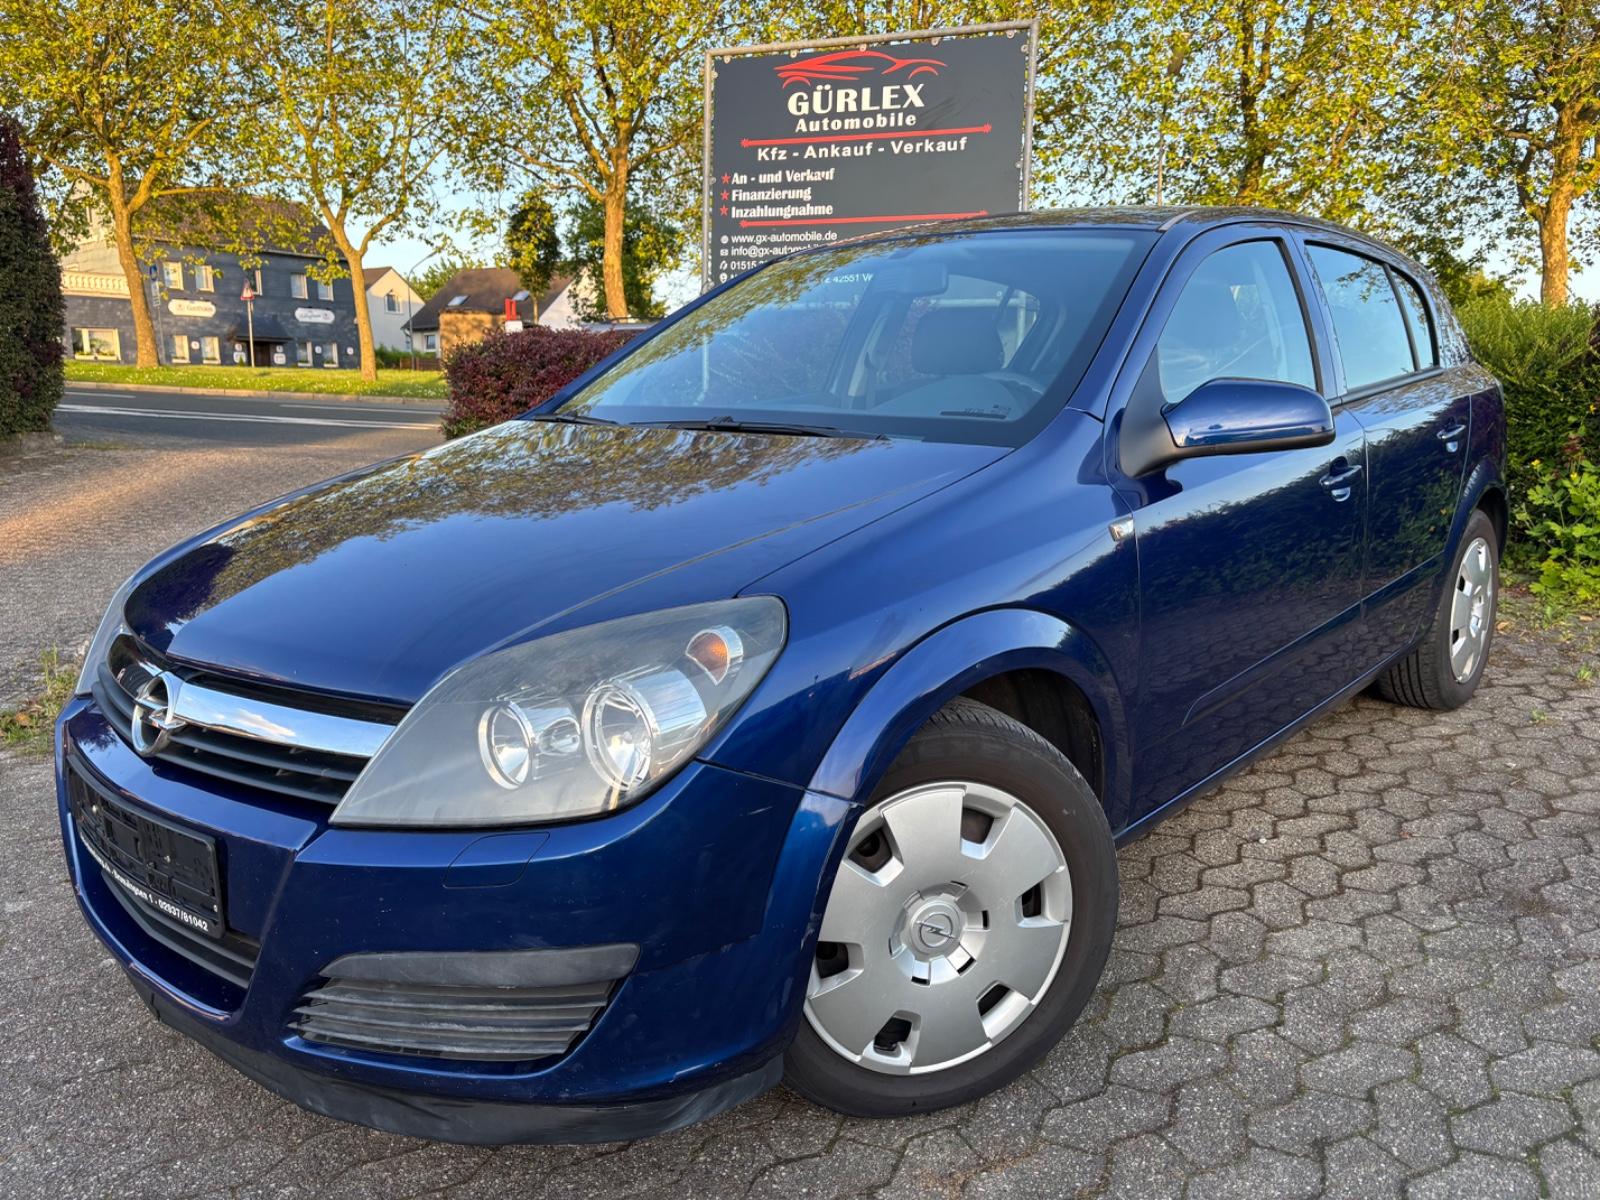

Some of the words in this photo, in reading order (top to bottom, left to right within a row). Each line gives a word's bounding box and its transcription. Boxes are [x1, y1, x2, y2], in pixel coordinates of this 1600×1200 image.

[787, 83, 925, 116] GÜRLEX
[795, 112, 917, 133] Automobile
[757, 147, 787, 161] Kfz
[803, 143, 873, 159] Ankauf
[890, 137, 968, 154] Verkauf
[731, 172, 748, 184] An
[758, 170, 782, 184] und
[785, 168, 835, 182] Verkauf
[731, 187, 812, 202] Finanzierung
[731, 203, 834, 219] Inzahlungnahme
[731, 230, 838, 245] www.gx-automobile.de
